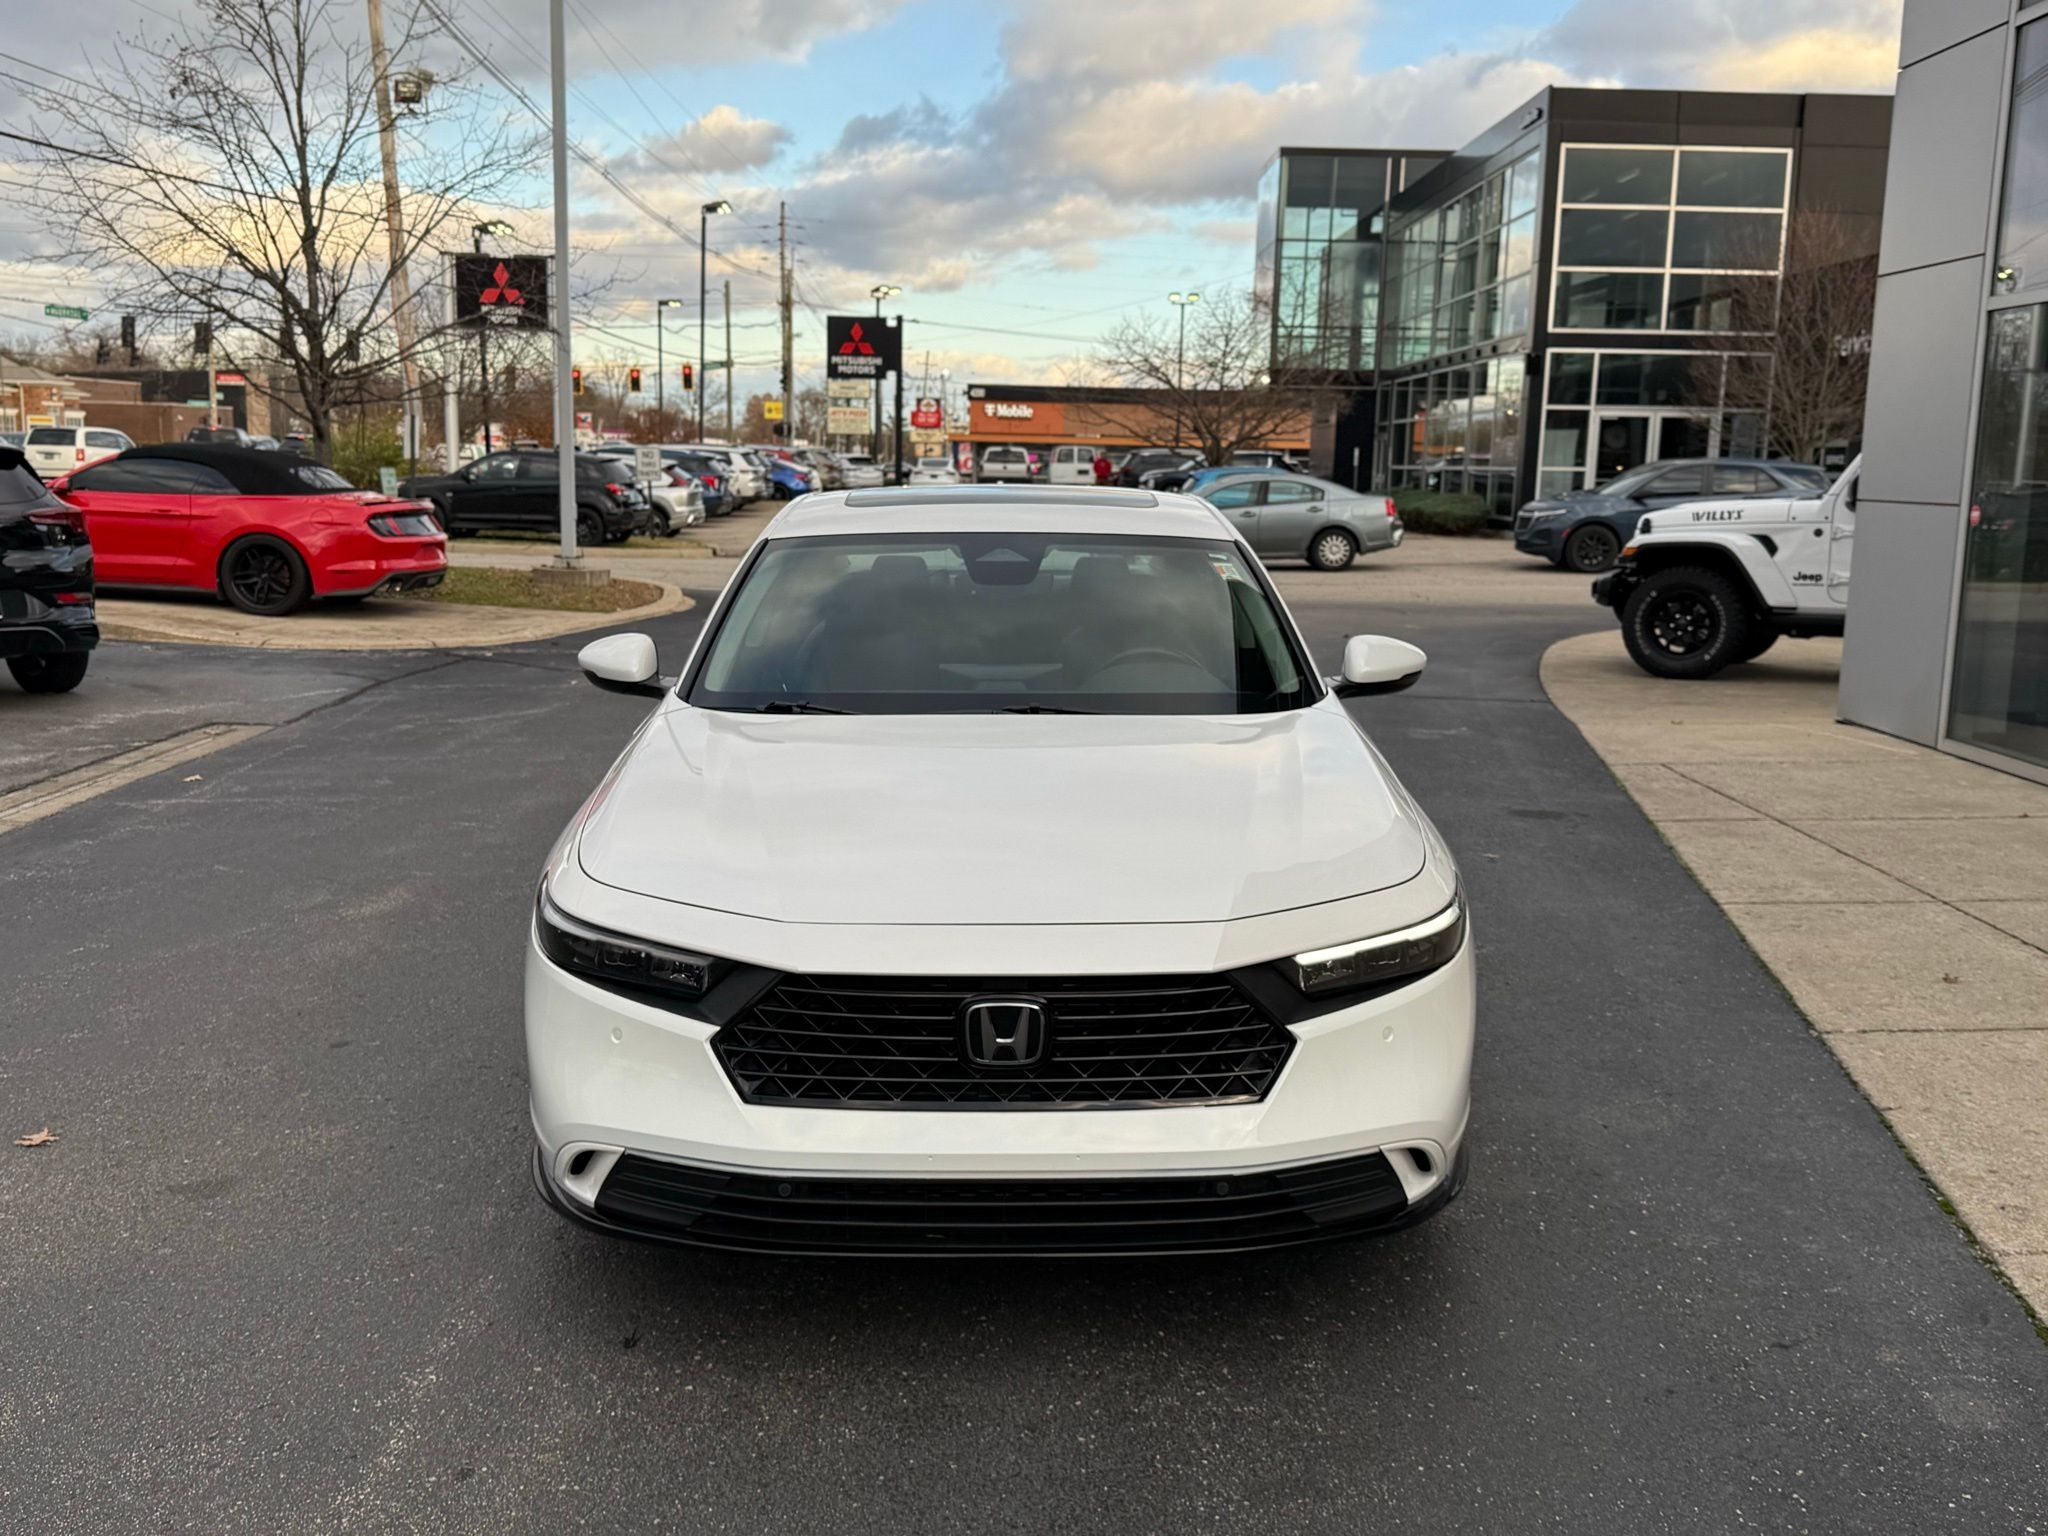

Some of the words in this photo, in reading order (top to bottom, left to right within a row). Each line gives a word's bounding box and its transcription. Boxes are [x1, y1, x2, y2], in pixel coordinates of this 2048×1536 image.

[831, 355, 883, 366] MITSUBISHI
[838, 365, 876, 375] MOTORS
[641, 451, 654, 459] NO
[1692, 510, 1744, 522] WILLYS
[1793, 571, 1823, 583] Jeep
